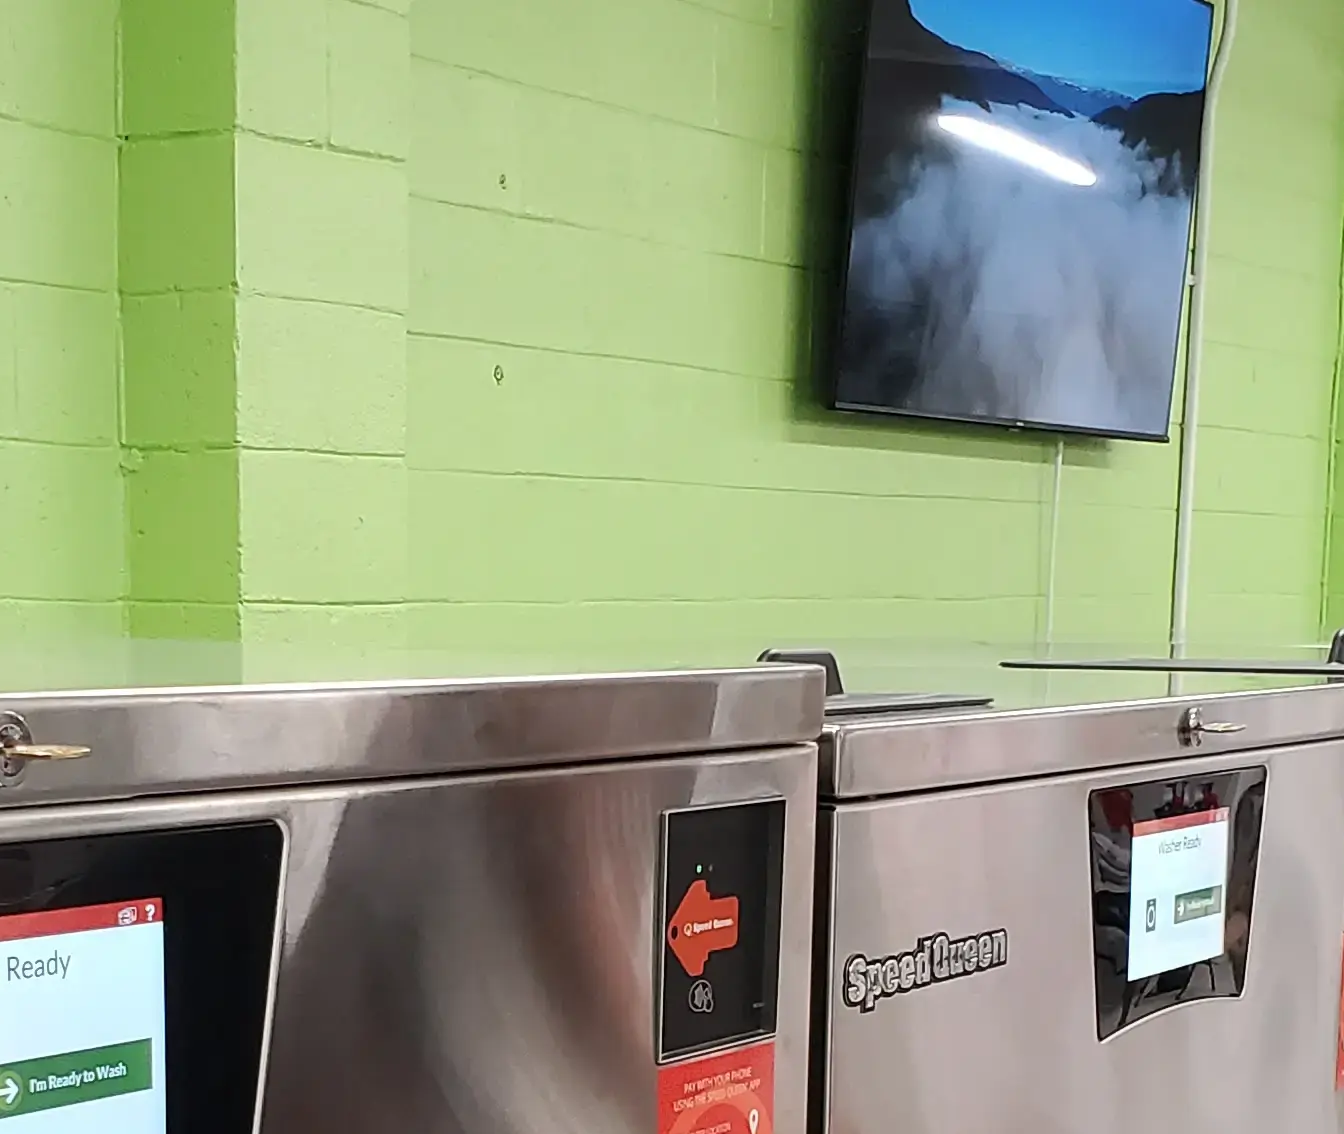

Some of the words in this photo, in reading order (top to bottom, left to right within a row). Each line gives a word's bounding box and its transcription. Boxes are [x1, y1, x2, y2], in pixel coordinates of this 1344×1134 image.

[6, 949, 72, 982] Ready
[845, 937, 931, 1012] Speed
[931, 930, 1007, 981] Queen
[29, 1077, 48, 1094] I'm
[48, 1071, 82, 1090] Ready
[82, 1071, 95, 1084] to
[96, 1062, 127, 1080] Wash
